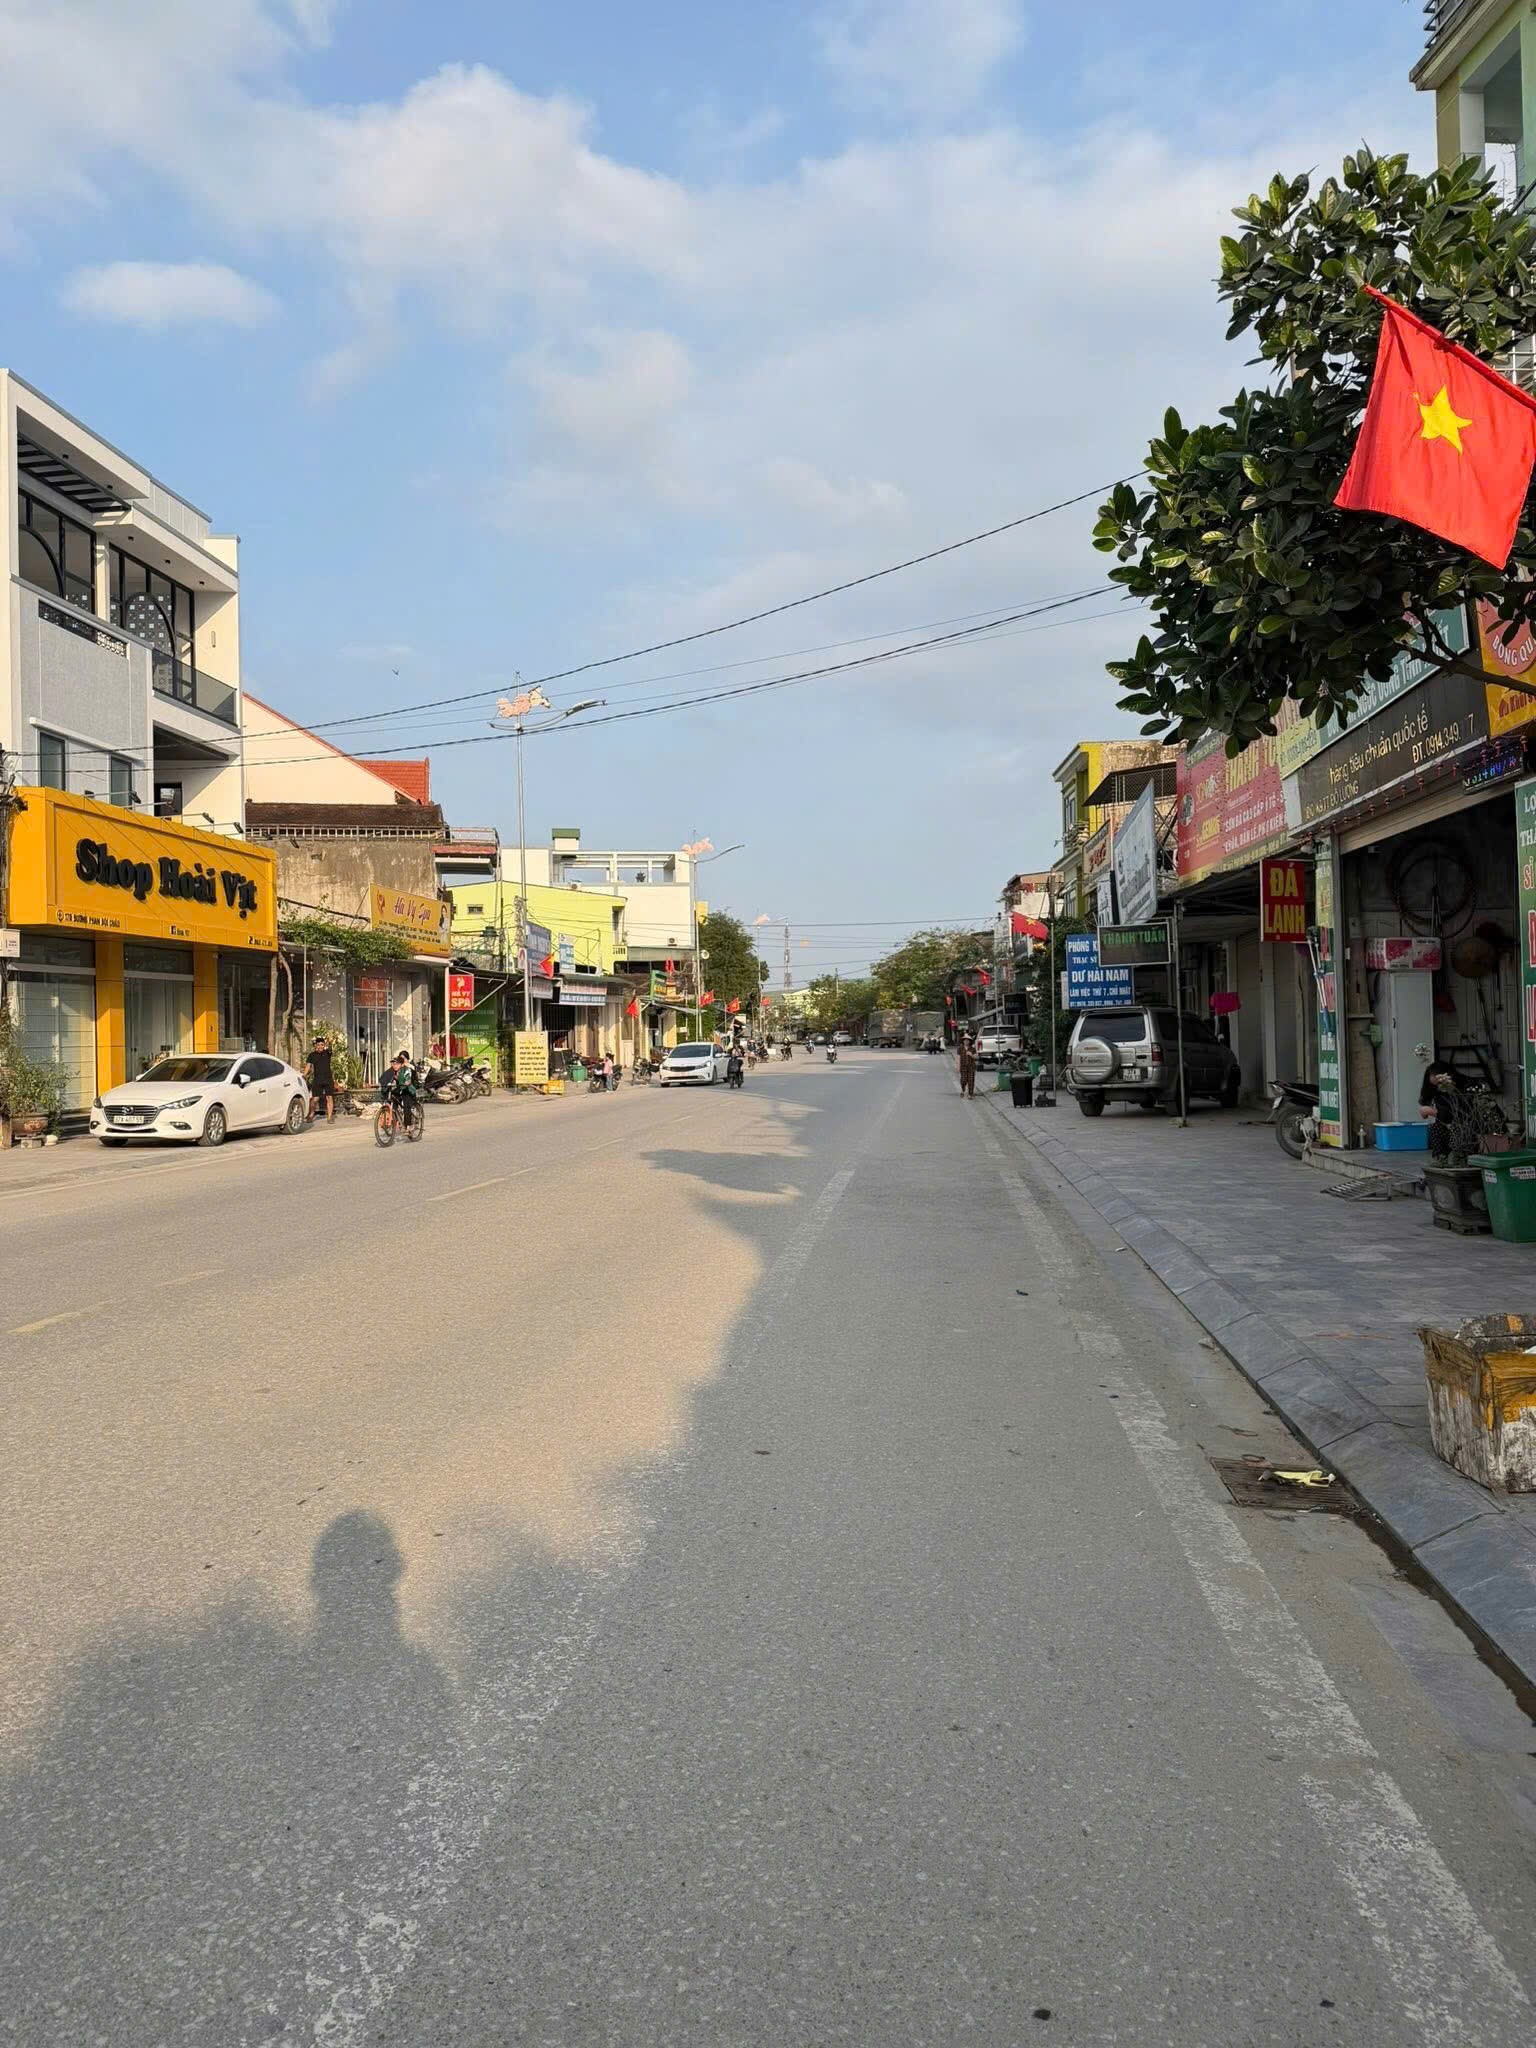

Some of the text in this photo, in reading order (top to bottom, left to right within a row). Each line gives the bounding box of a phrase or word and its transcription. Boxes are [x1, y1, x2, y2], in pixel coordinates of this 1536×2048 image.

[1330, 762, 1349, 786] hàng
[1365, 730, 1392, 765] chuẩn
[1392, 714, 1416, 749] quốc
[1417, 703, 1429, 734] tế
[75, 838, 258, 920] Shop Hoài Vịt
[1270, 862, 1299, 897] ĐÁ
[1103, 931, 1135, 945] THANH
[1264, 903, 1306, 940] LẠNH
[1105, 968, 1129, 982] NAM
[451, 998, 471, 1008] SPA
